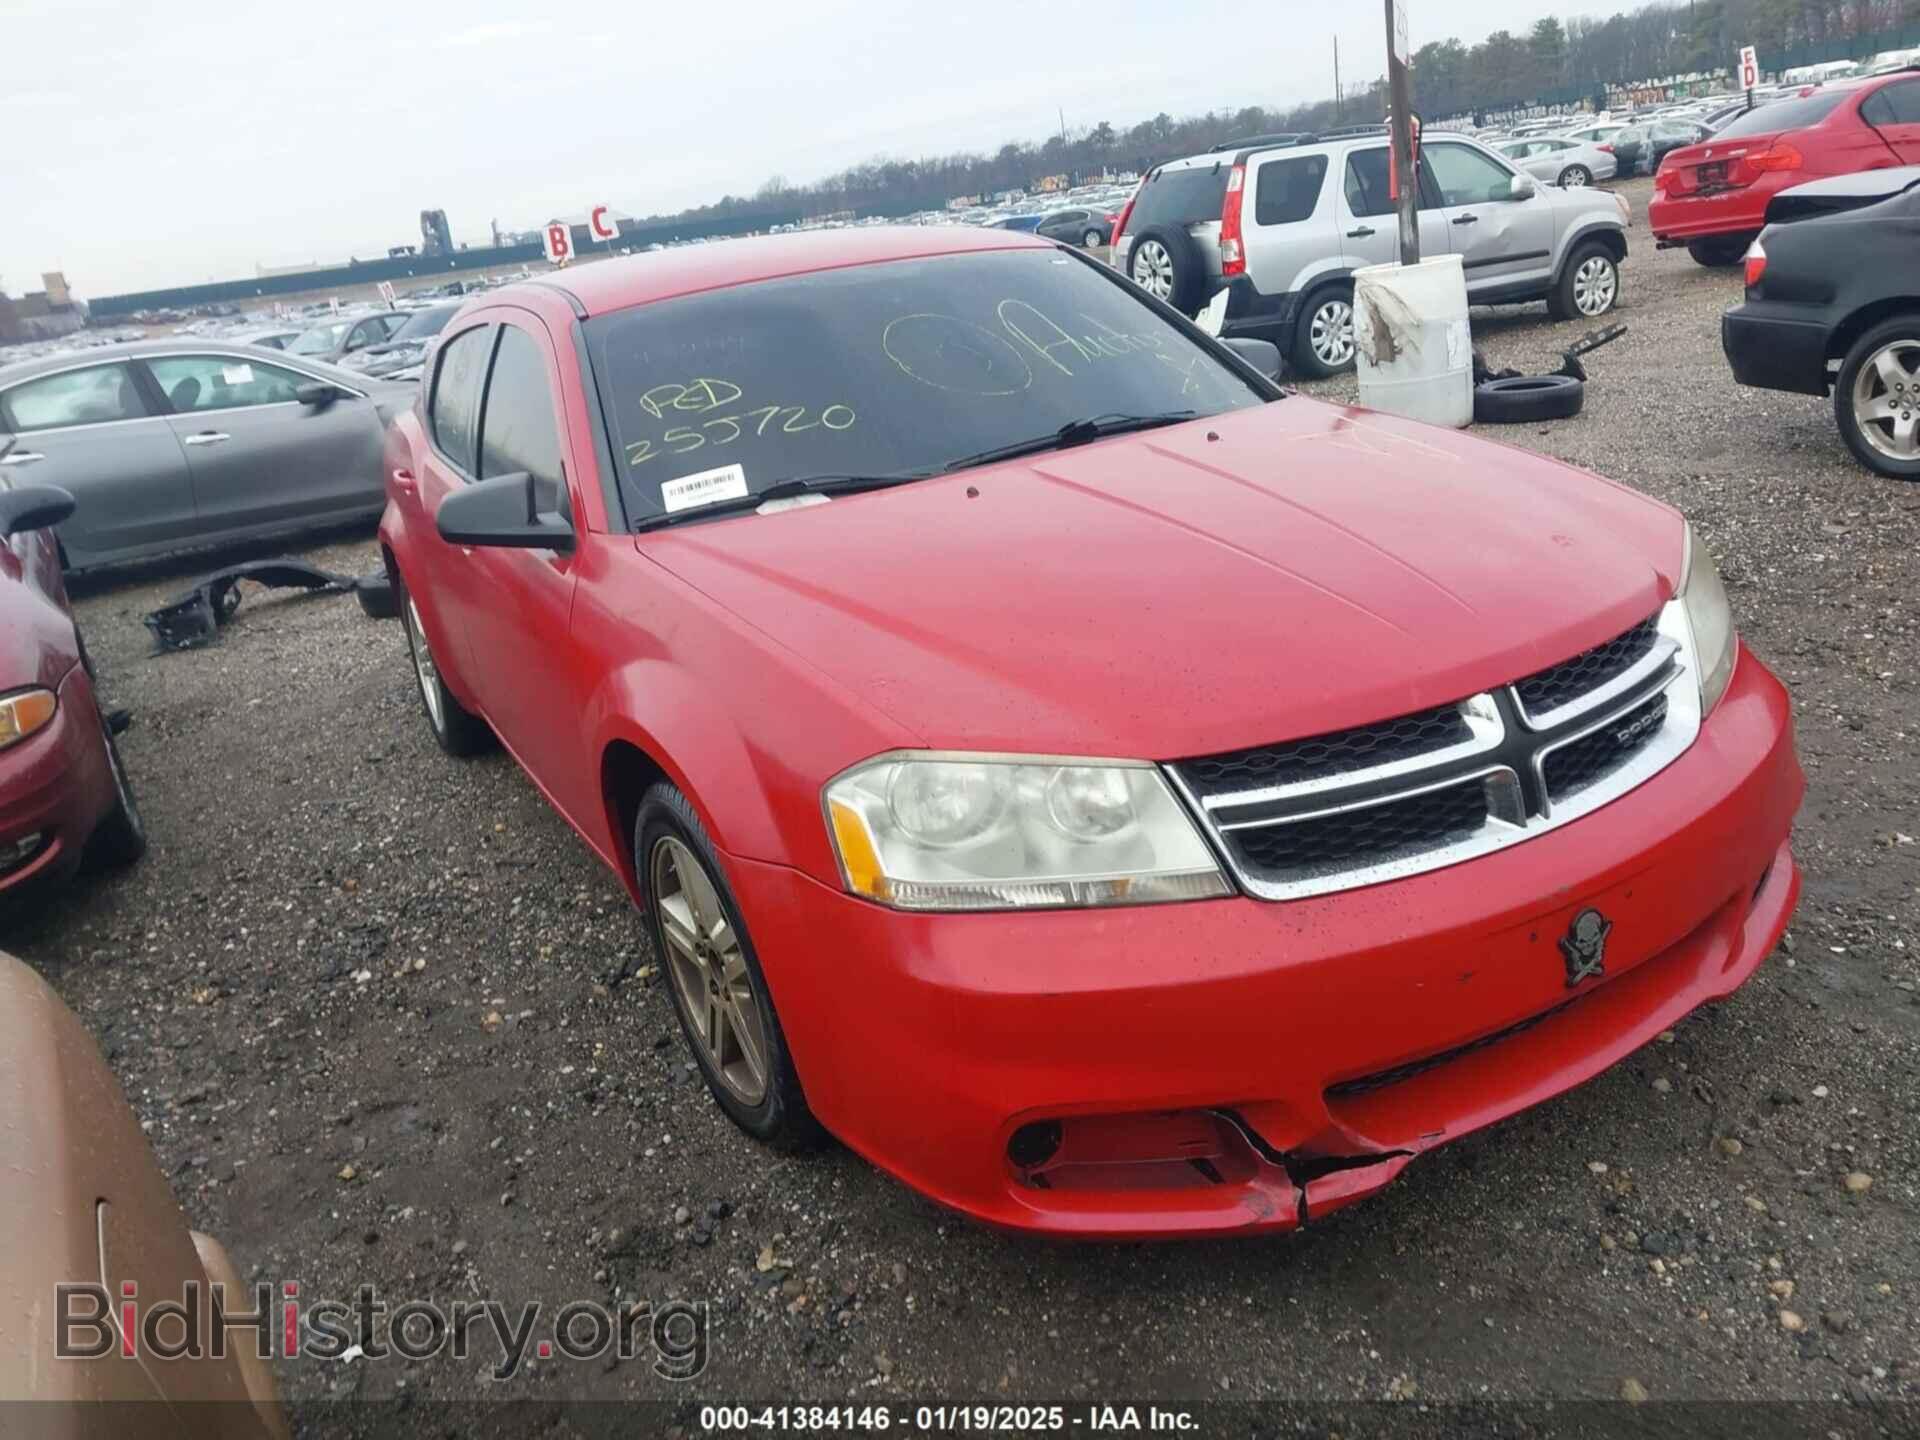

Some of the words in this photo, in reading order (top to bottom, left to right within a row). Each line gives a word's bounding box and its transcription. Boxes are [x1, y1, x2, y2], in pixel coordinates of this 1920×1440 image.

[1744, 66, 1755, 86] D
[592, 206, 613, 237] C
[548, 227, 568, 257] B
